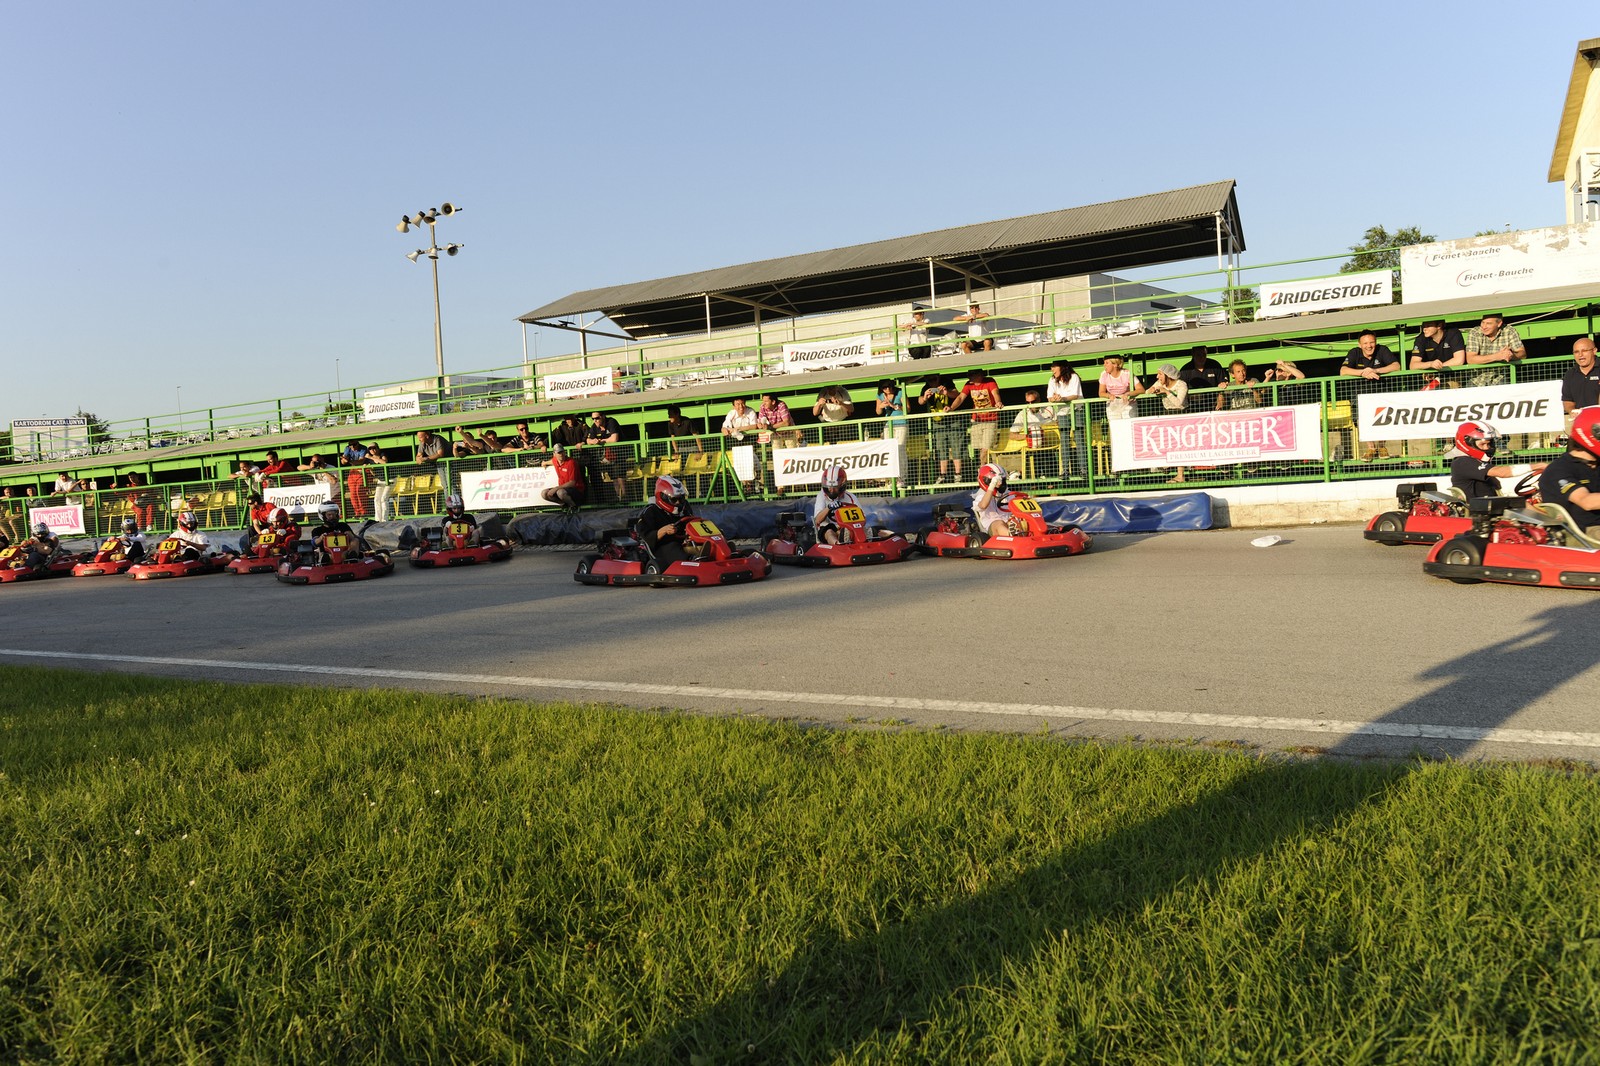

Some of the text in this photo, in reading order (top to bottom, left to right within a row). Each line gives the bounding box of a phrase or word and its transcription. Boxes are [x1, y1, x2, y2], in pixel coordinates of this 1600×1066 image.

[1269, 282, 1383, 306] BRIDGESTONE
[789, 344, 865, 362] BRIDGESTONE
[549, 376, 608, 391] BRIDGESTONE
[368, 400, 416, 414] BRIDGESTONE
[1371, 398, 1549, 427] BRIDGESTONE
[1140, 416, 1286, 456] KINGFISHER
[1169, 449, 1257, 461] PREMIUM LAGER BEER
[782, 452, 890, 475] BRIDGESTONE
[503, 472, 547, 482] SAHARA
[268, 493, 327, 508] BRIDGESTONE
[1019, 501, 1037, 511] 10
[34, 510, 78, 527] KINGFISHER
[843, 509, 860, 521] 15
